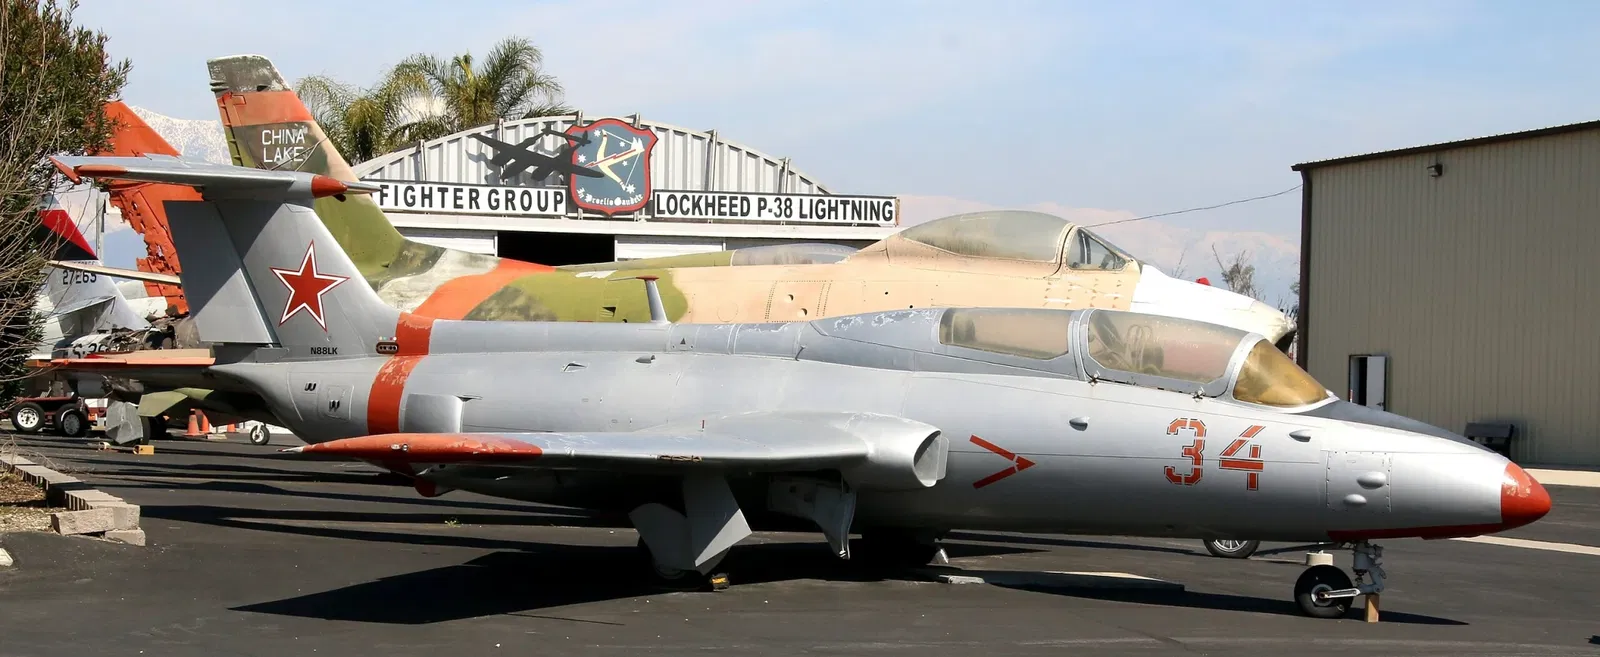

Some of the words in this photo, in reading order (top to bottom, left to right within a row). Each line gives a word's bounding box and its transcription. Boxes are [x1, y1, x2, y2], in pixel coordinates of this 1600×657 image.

[261, 129, 306, 146] CHINA
[263, 146, 304, 163] LAKE
[379, 184, 481, 210] FIGHTER
[487, 188, 565, 213] GROUP
[656, 193, 751, 217] LOCKHEED
[757, 197, 793, 218] P-38
[799, 198, 894, 222] LIGHTNING
[310, 346, 338, 355] N88LK
[1164, 417, 1266, 491] 34
